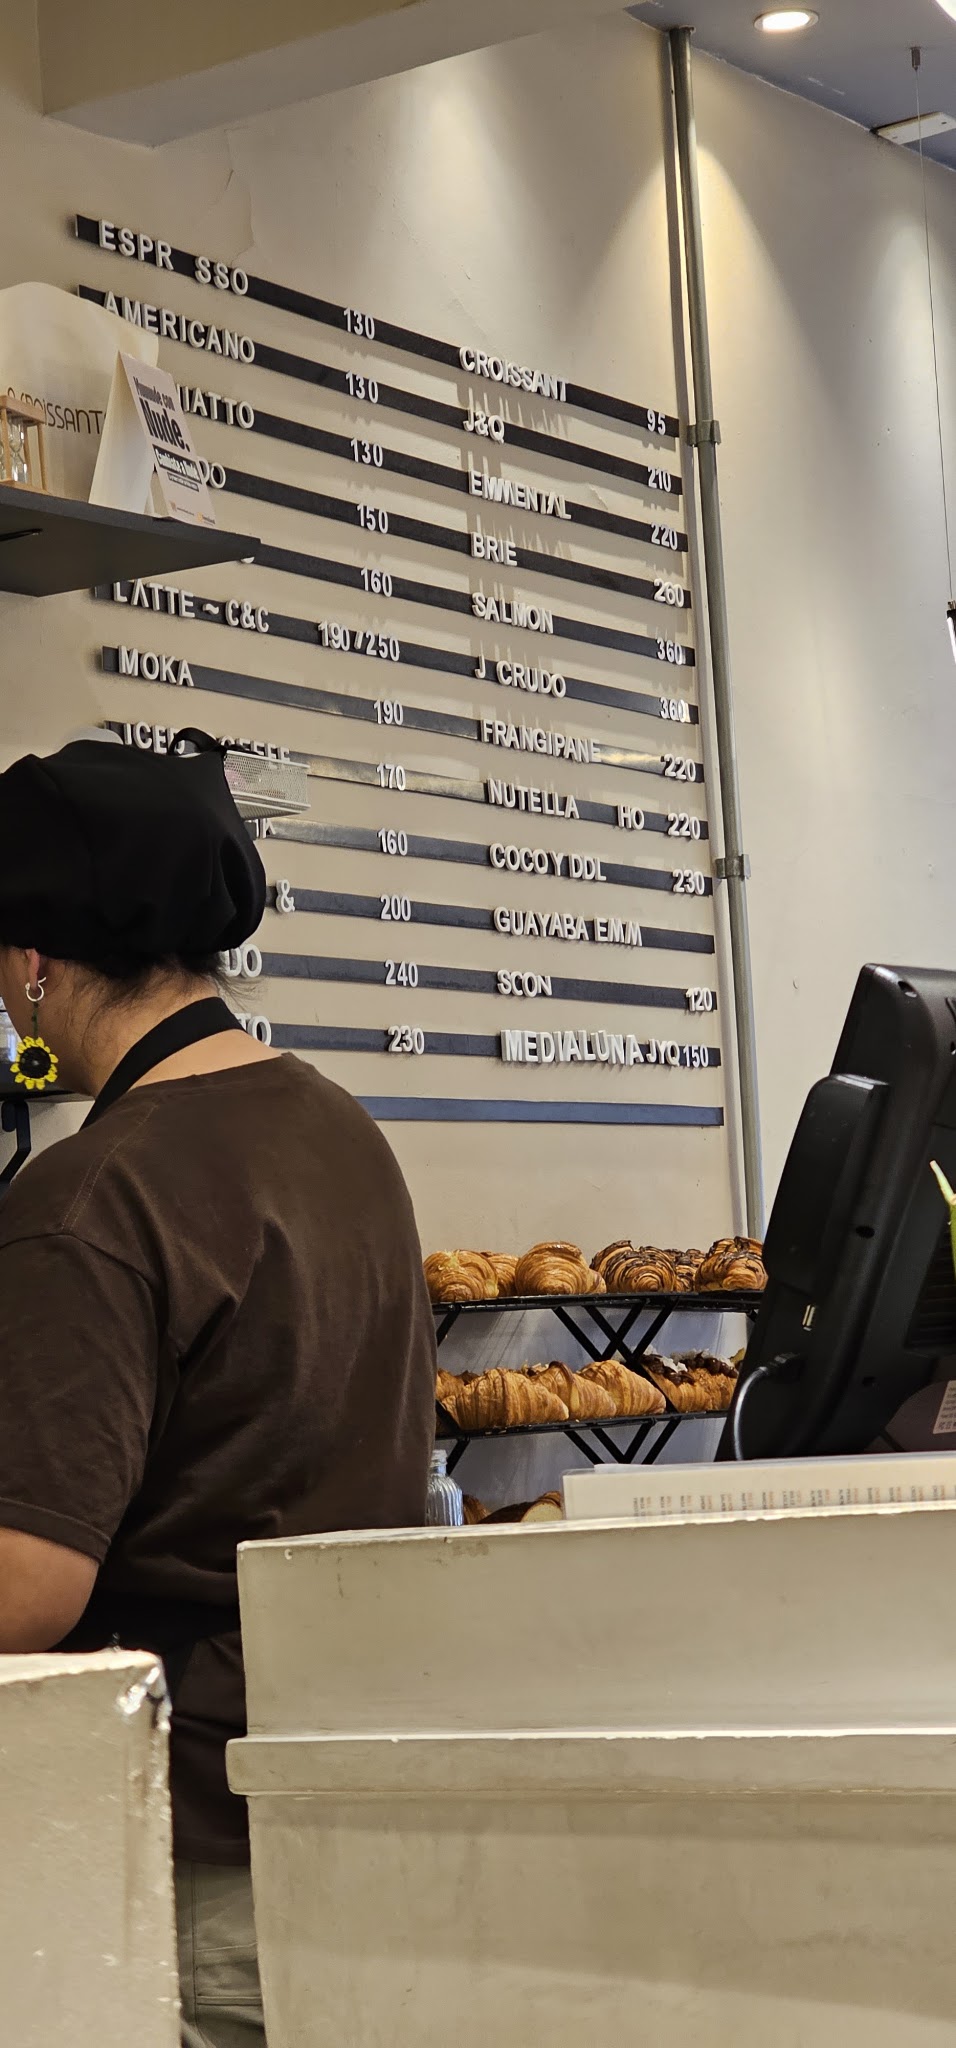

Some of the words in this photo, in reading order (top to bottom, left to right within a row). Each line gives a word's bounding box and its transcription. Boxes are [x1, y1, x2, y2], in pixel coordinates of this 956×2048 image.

[104, 290, 255, 363] AMERICANO
[343, 307, 376, 340] 130
[345, 370, 379, 404] 130
[459, 346, 569, 402] CROISSANT
[177, 383, 255, 429] IATTO
[139, 397, 190, 453] Nude.
[463, 401, 505, 443] J&Q
[647, 409, 666, 436] 95
[350, 437, 384, 467] 130
[648, 466, 671, 493] 210
[468, 470, 572, 520] EMMENTAL
[357, 503, 389, 534] 150
[471, 532, 518, 566] BRIE
[651, 523, 678, 551] 220
[361, 567, 393, 597] 160
[654, 578, 684, 607] 260
[113, 578, 196, 618] LATTE
[225, 600, 270, 633] C&C
[472, 592, 554, 634] SALMON
[118, 645, 195, 687] MOKA
[657, 637, 686, 665] 360
[496, 660, 567, 698] CRUDO
[373, 699, 404, 726] 190
[481, 719, 602, 763] FRANGIPANE
[376, 762, 406, 791] 170
[663, 753, 696, 781] 220
[487, 778, 580, 819] NUTELLA
[617, 805, 645, 830] HO
[668, 813, 700, 840] 220
[376, 828, 408, 856] 160
[569, 854, 607, 881] DDL
[673, 869, 705, 895] 230
[380, 894, 411, 921] 200
[494, 907, 589, 941] GUAYABA
[594, 917, 643, 947] EMM
[384, 959, 419, 987] 240
[497, 970, 552, 998] SCON
[686, 987, 713, 1012] 120
[387, 1025, 425, 1055] 230
[500, 1029, 645, 1067] MEDIALUNA
[646, 1038, 680, 1067] JYQ
[683, 1044, 709, 1068] 150
